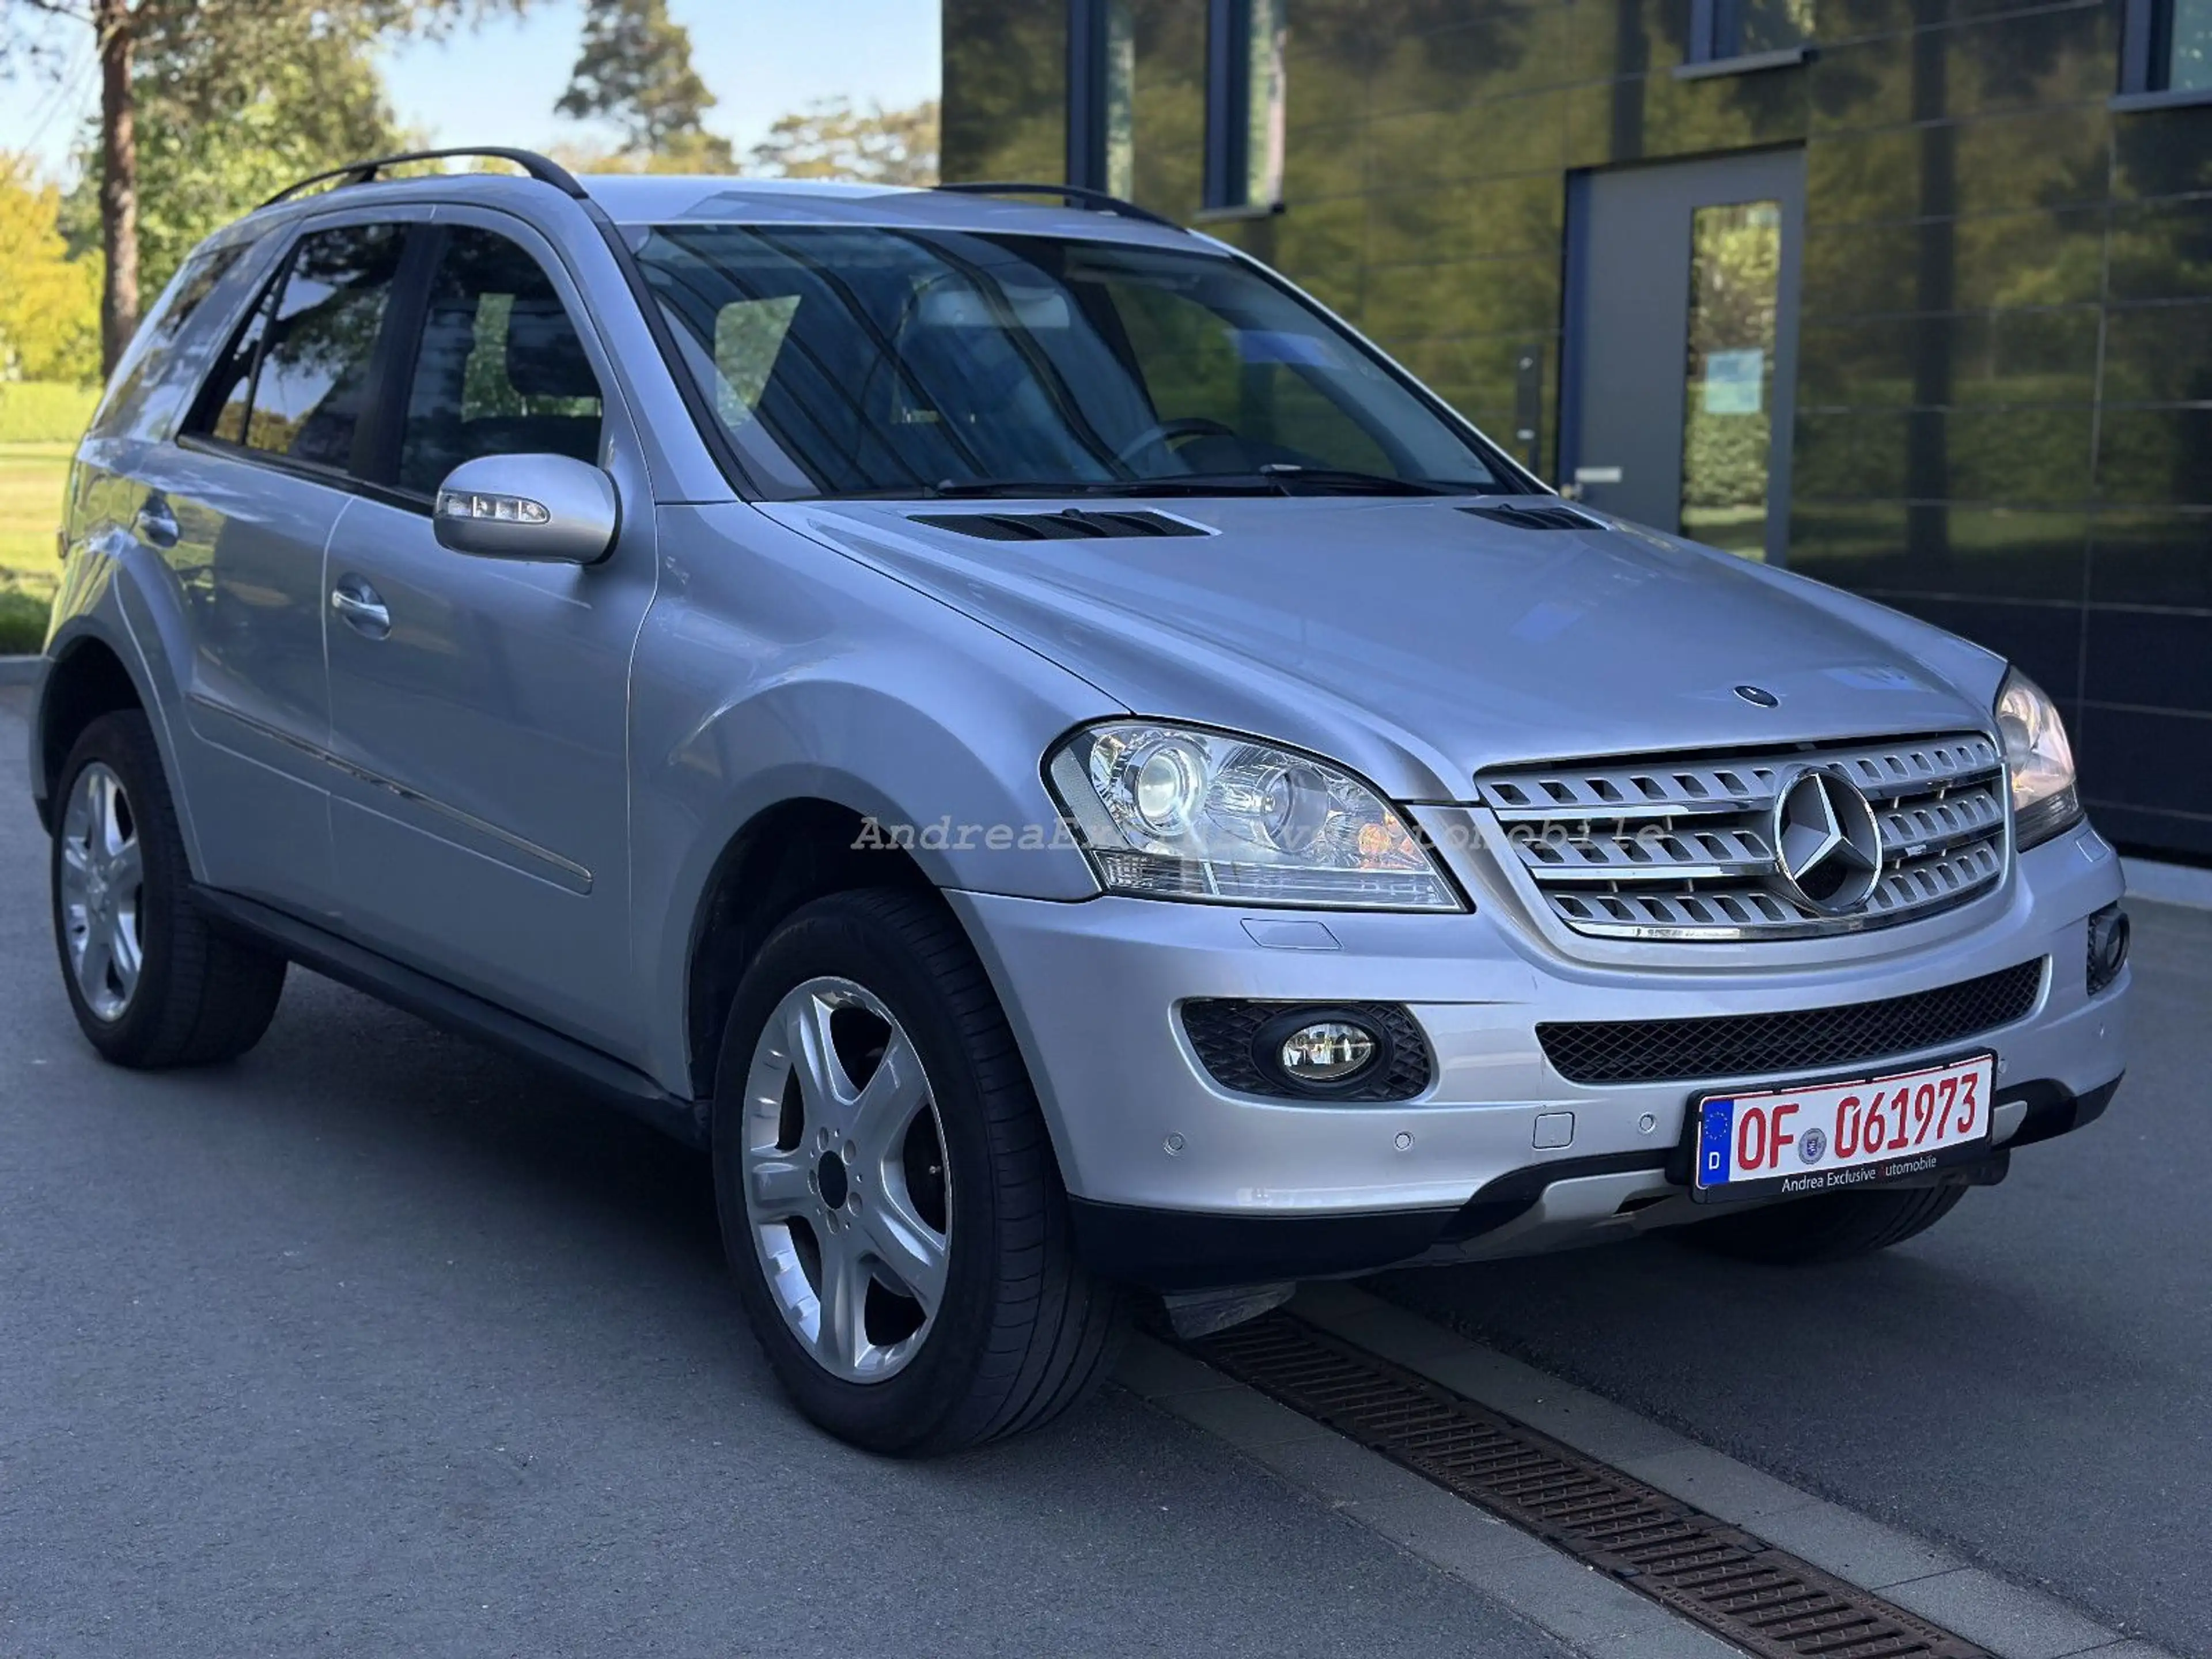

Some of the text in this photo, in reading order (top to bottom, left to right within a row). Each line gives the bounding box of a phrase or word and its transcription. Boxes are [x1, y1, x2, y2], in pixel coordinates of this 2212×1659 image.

[1737, 1104, 1799, 1171] OF
[1834, 1073, 1978, 1158] 061973
[1709, 1152, 1719, 1170] D
[1782, 1155, 1937, 1192] Andrea Exclusive utomobile
